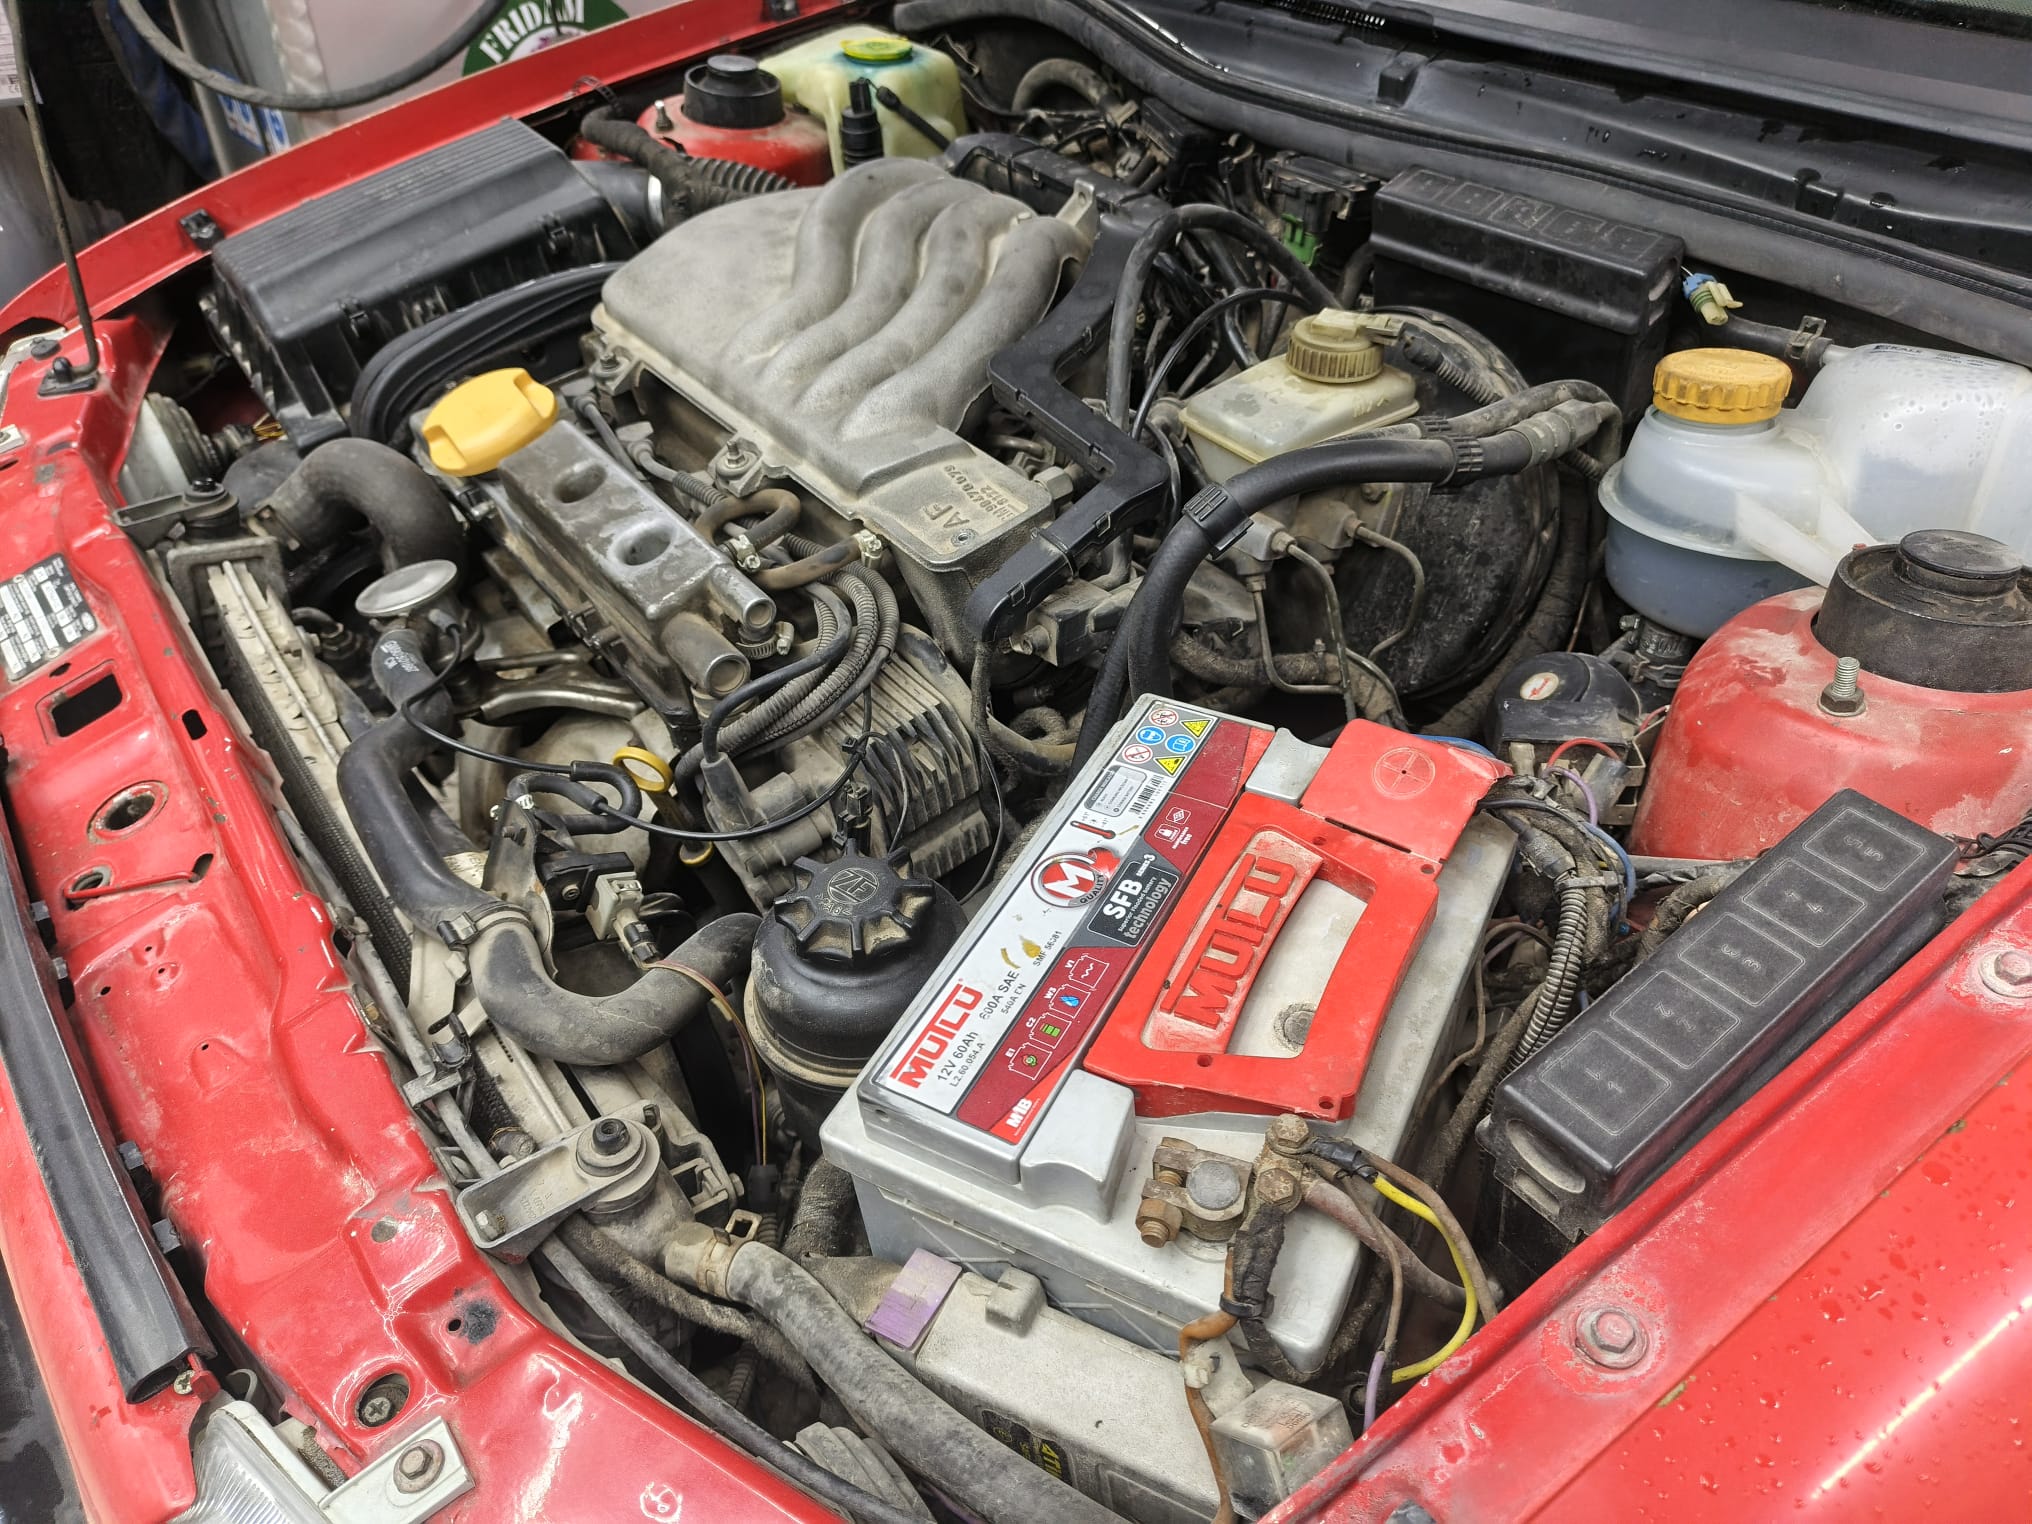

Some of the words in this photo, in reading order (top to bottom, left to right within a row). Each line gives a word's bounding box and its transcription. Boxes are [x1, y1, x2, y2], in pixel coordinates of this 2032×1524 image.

[1079, 873, 1105, 905] QUALITY
[1103, 878, 1144, 920] SFB
[1123, 877, 1173, 939] technology
[998, 969, 1020, 997] SAE
[889, 983, 984, 1089] MUTLU
[937, 1058, 959, 1082] 12V
[952, 1031, 979, 1060] 60Ah
